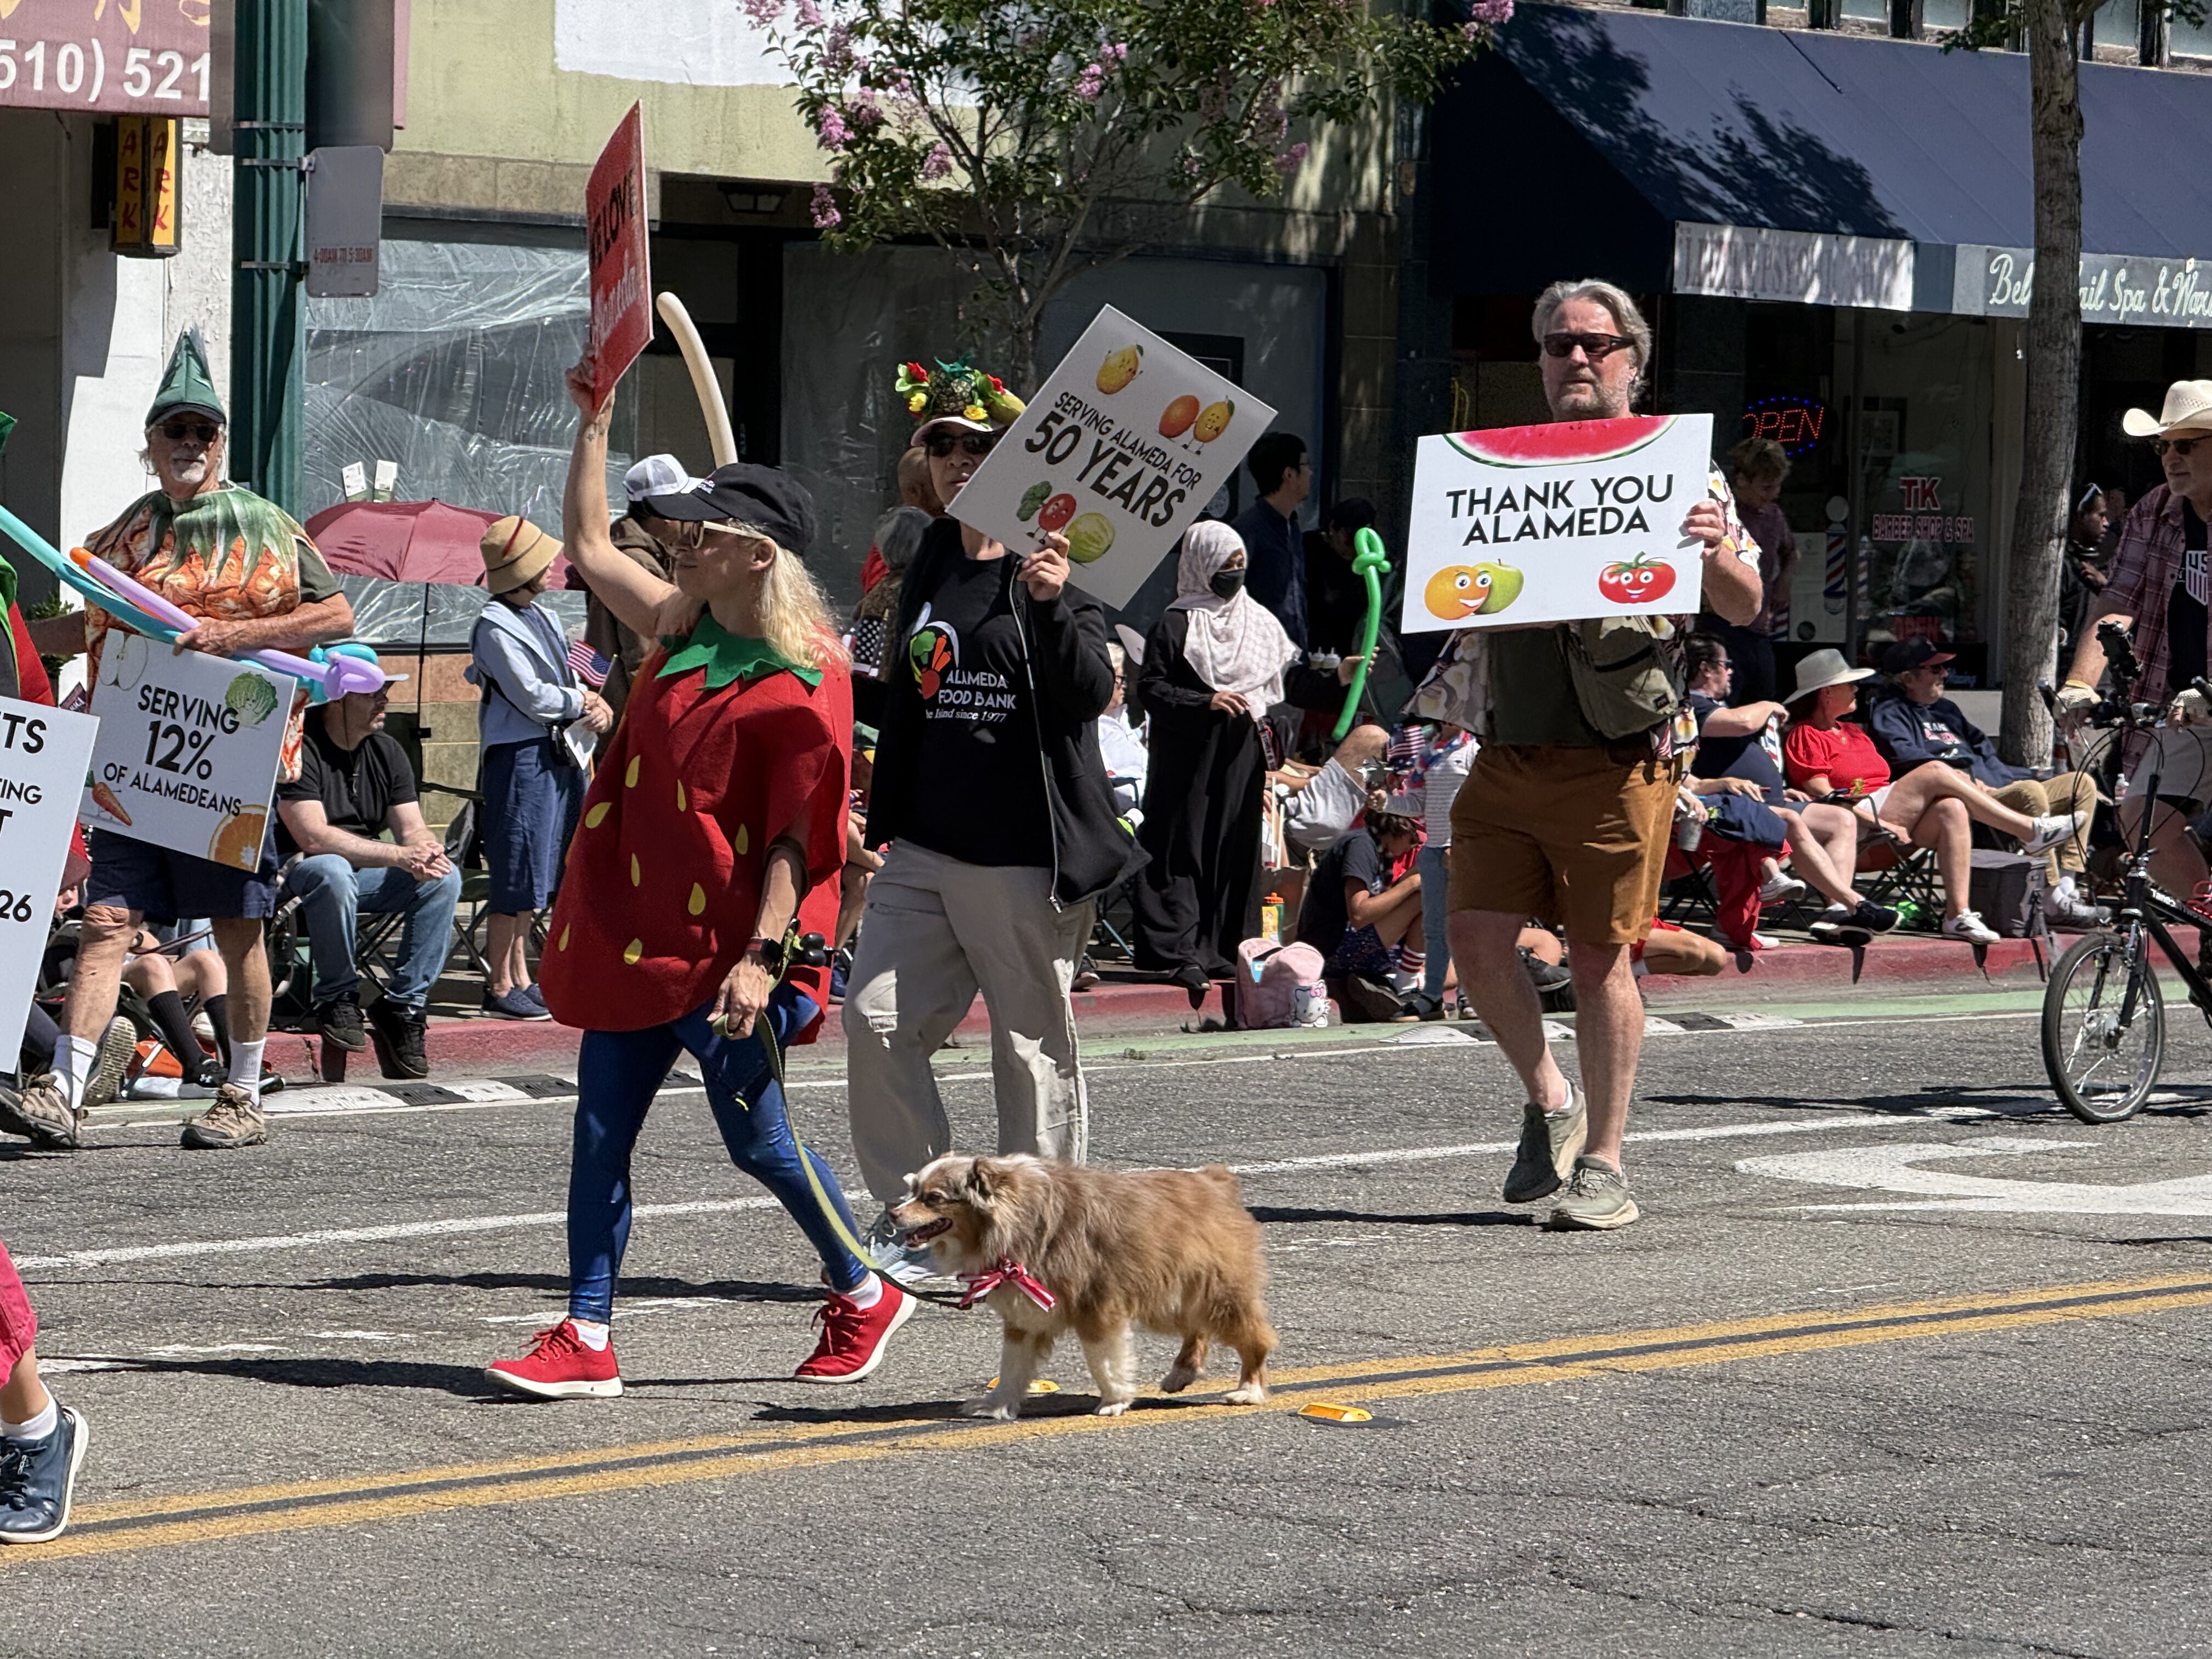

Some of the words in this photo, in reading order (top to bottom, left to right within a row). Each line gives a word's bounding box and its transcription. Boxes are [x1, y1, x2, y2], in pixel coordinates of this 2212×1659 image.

[2109, 268, 2146, 321] Spa
[2152, 266, 2170, 314] &
[1054, 391, 1114, 436] SERVING
[1113, 426, 1172, 475] ALAMEDA
[1172, 464, 1203, 490] FOR
[1024, 410, 1081, 466] 50
[1075, 438, 1187, 528] YEARS
[1445, 479, 1576, 519] THANK
[1590, 473, 1674, 506] YOU
[1898, 477, 1942, 511] TK
[1462, 504, 1651, 548] ALAMEDA
[1872, 514, 1914, 541] BARBER
[1915, 515, 1943, 543] SHOP
[1955, 516, 1975, 543] SPA
[137, 684, 240, 735] SERVING
[938, 689, 972, 705] FOOD
[974, 691, 1017, 710] BANK
[955, 709, 978, 720] since
[981, 710, 1007, 723] 1977
[0, 711, 47, 754] TS
[144, 719, 217, 780] 12%
[0, 778, 42, 805] ING
[103, 762, 128, 783] OF
[128, 770, 242, 816] ALAMEDEANS
